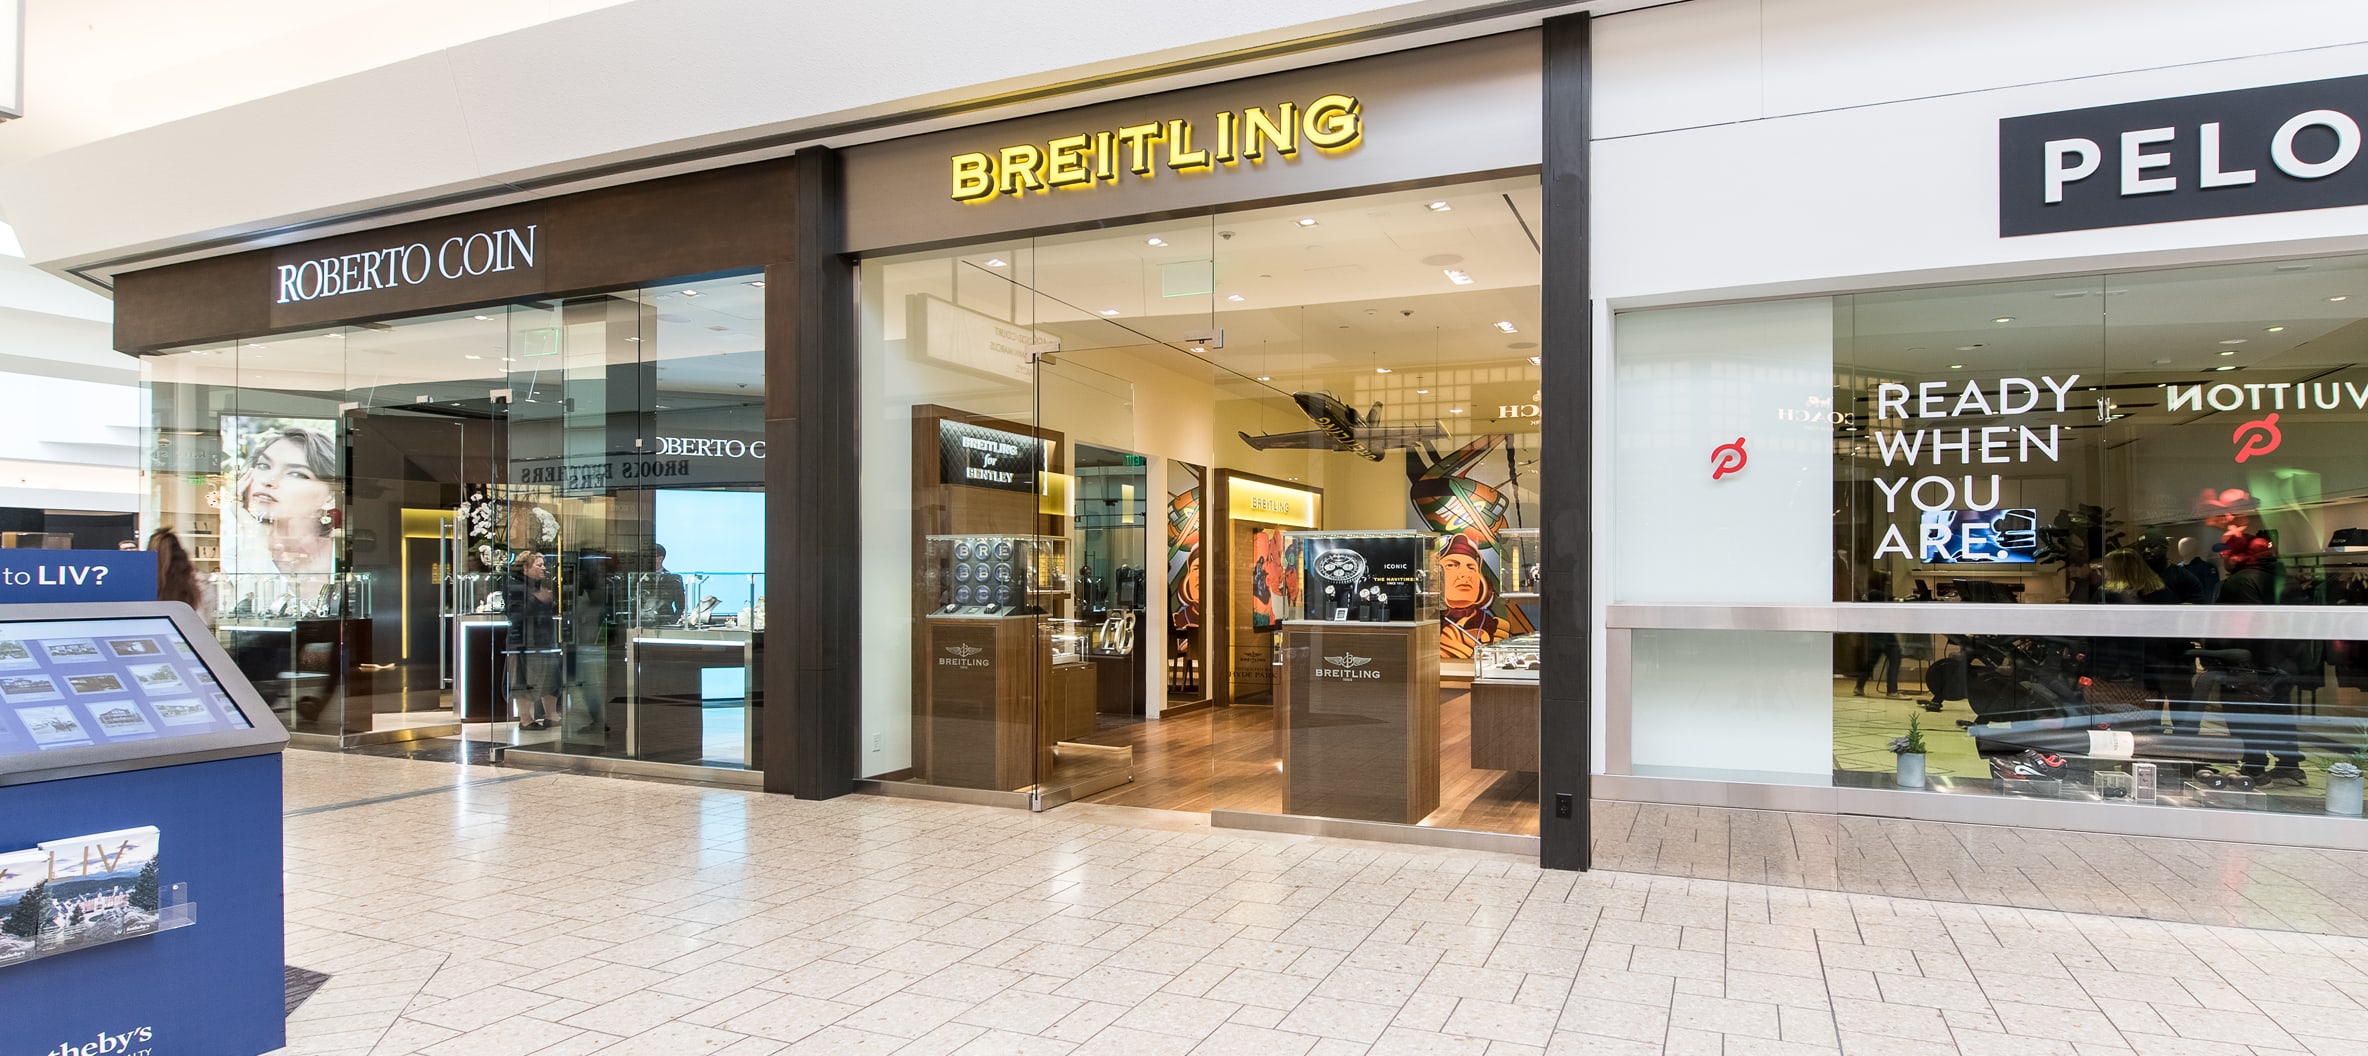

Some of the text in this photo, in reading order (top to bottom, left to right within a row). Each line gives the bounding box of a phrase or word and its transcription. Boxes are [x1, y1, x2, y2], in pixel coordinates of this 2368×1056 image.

[950, 93, 1361, 202] BREITLING
[2044, 109, 2362, 205] PELO
[277, 224, 537, 304] ROBERTO COIN
[1878, 374, 2080, 420] READY
[962, 436, 1018, 456] BREITLING
[983, 453, 997, 468] for
[1875, 424, 2058, 467] WHEN
[966, 467, 1014, 483] BENTLEY
[1252, 496, 1289, 513] BREITLING
[1873, 475, 2000, 513] YOU
[1873, 523, 2009, 560] ARE.
[2, 565, 109, 585] to LIV?
[939, 658, 989, 667] BREITLING
[1315, 669, 1381, 679] BREITLING
[48, 840, 128, 883] LIV
[48, 1027, 153, 1056] heby's
